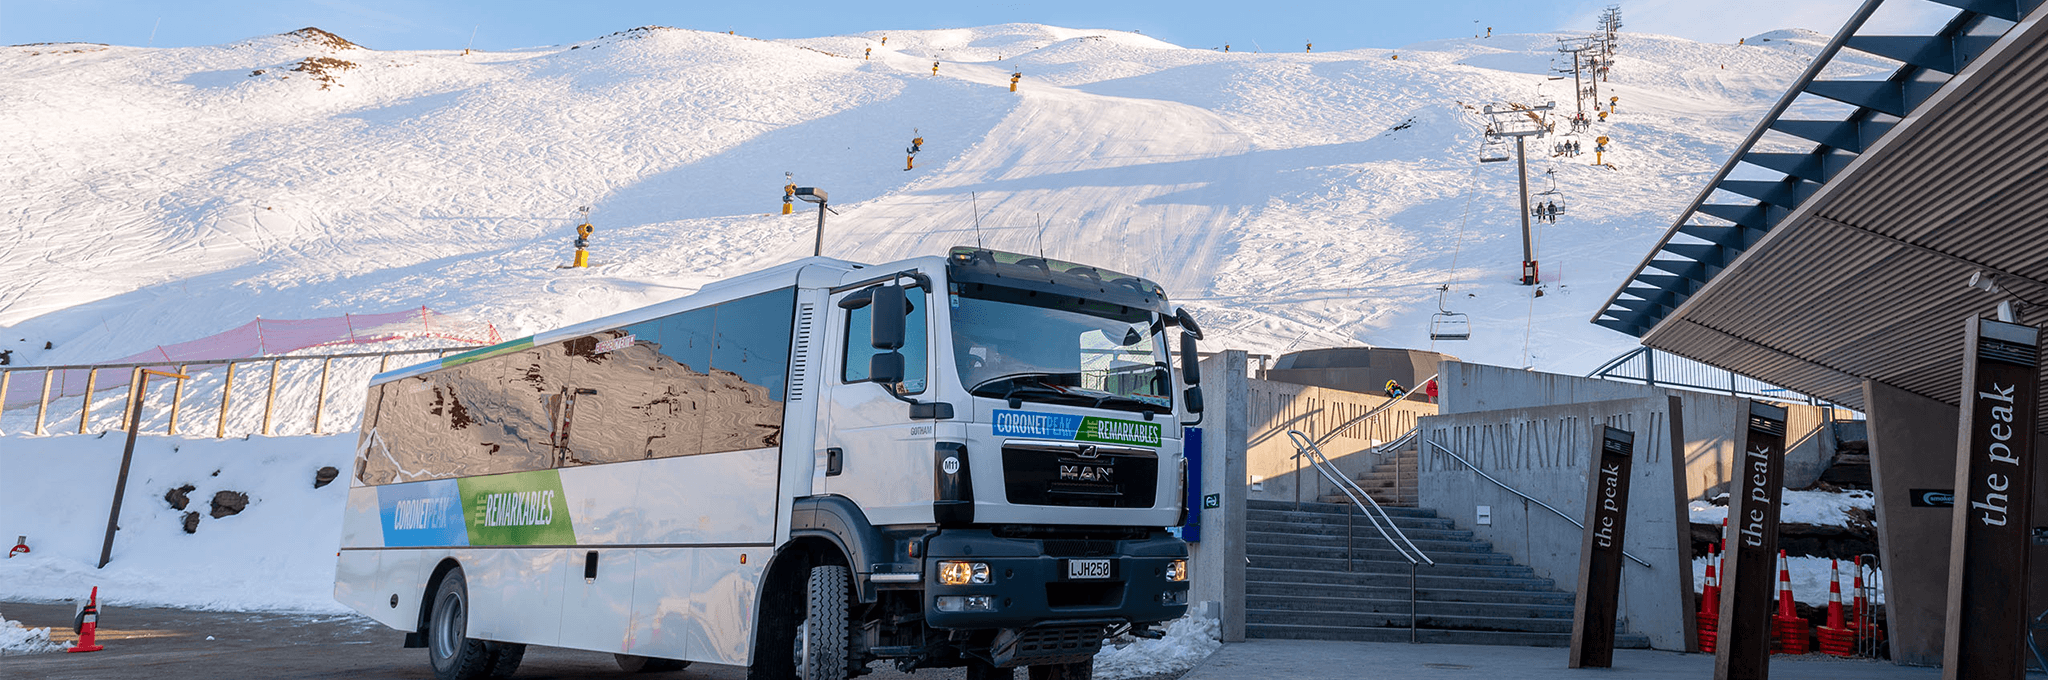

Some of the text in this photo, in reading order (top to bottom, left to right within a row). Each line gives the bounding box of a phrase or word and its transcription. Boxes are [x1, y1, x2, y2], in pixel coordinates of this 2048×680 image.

[911, 425, 932, 435] GOTHAM
[1087, 419, 1098, 438] THE
[1098, 420, 1159, 444] REMARKABLES
[944, 460, 958, 470] M11
[1972, 382, 2020, 526] the peak
[1060, 465, 1114, 482] MAN
[474, 494, 487, 526] THE
[485, 490, 554, 526] REMARKABLES
[1595, 463, 1619, 548] the peak
[1741, 445, 1770, 547] the peak
[1071, 562, 1109, 576] LJH250
